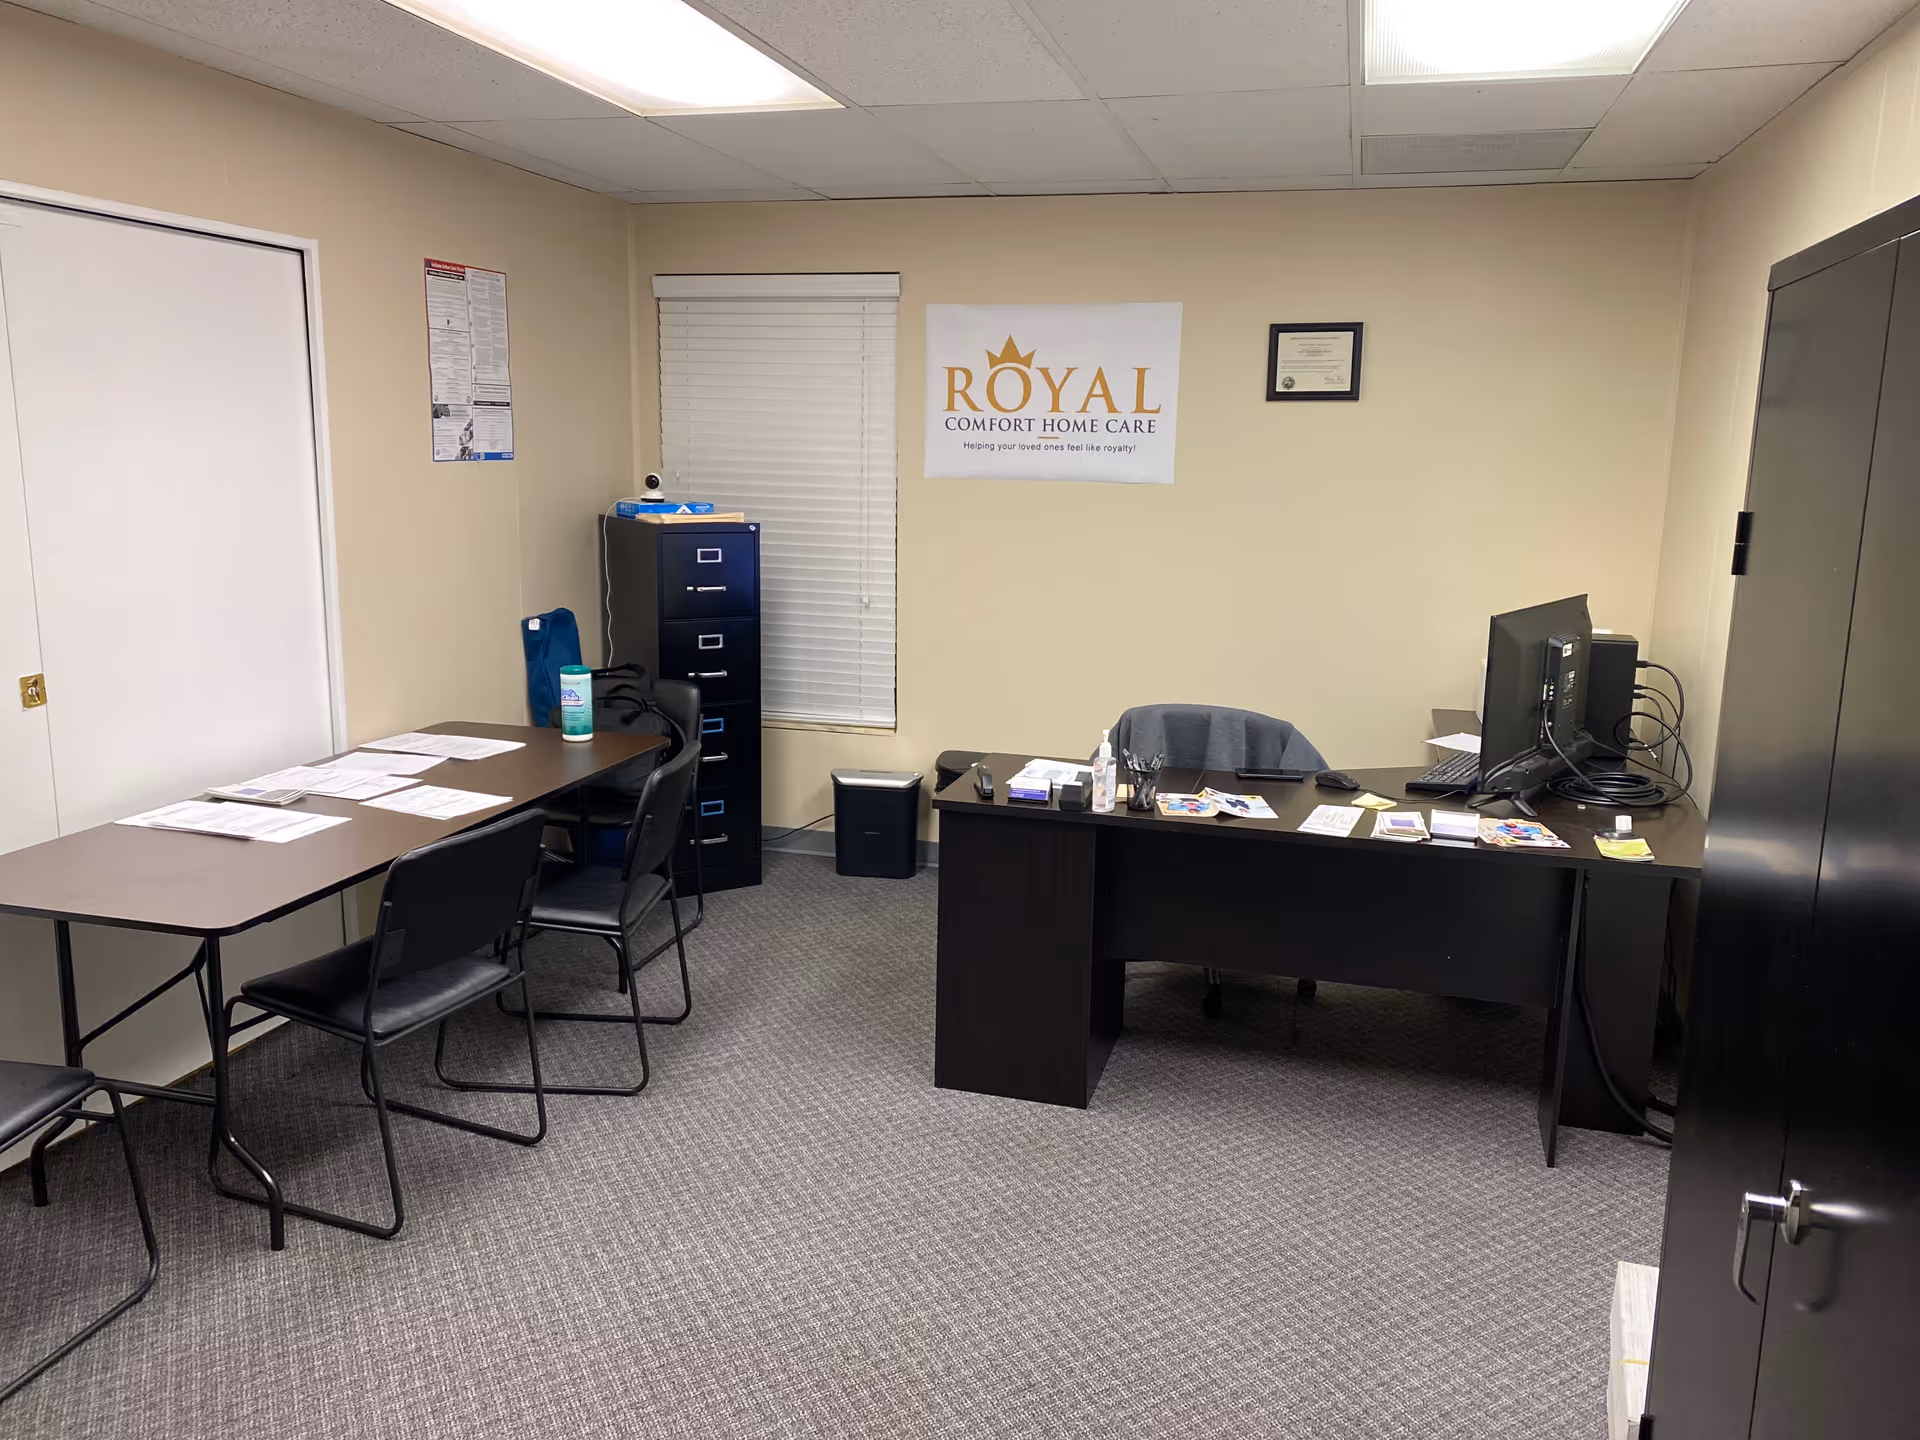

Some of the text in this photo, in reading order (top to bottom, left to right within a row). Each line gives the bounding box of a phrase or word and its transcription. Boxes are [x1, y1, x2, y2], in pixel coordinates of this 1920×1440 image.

[942, 366, 1161, 414] ROYAL
[945, 417, 1156, 433] COMFORT HOME CARE
[963, 442, 995, 451] Helping
[1018, 442, 1041, 451] loved
[1067, 443, 1083, 451] feel
[1086, 444, 1101, 452] like
[1103, 444, 1136, 453] royalty!
